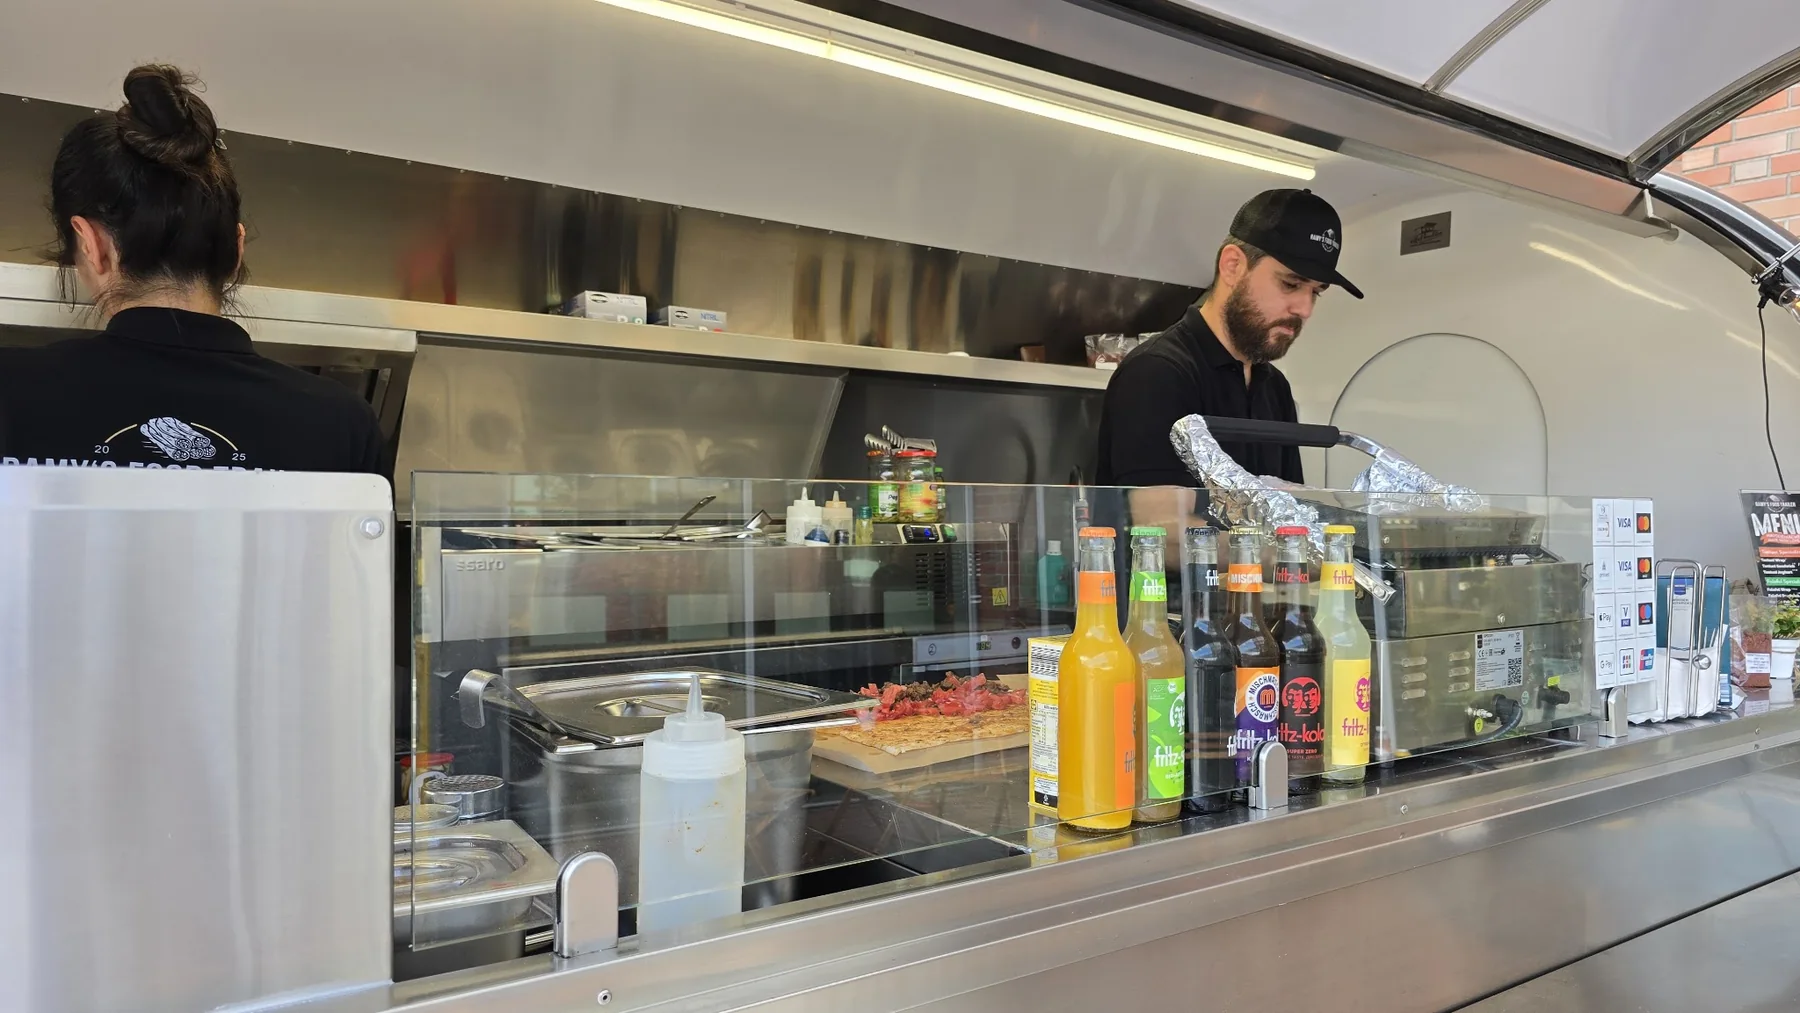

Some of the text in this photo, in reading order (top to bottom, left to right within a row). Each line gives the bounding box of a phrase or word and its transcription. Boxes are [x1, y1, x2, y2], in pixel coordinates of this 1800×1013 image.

[94, 444, 110, 454] 20
[232, 453, 247, 461] 25
[1617, 517, 1631, 528] VISA
[1618, 560, 1632, 571] VISA
